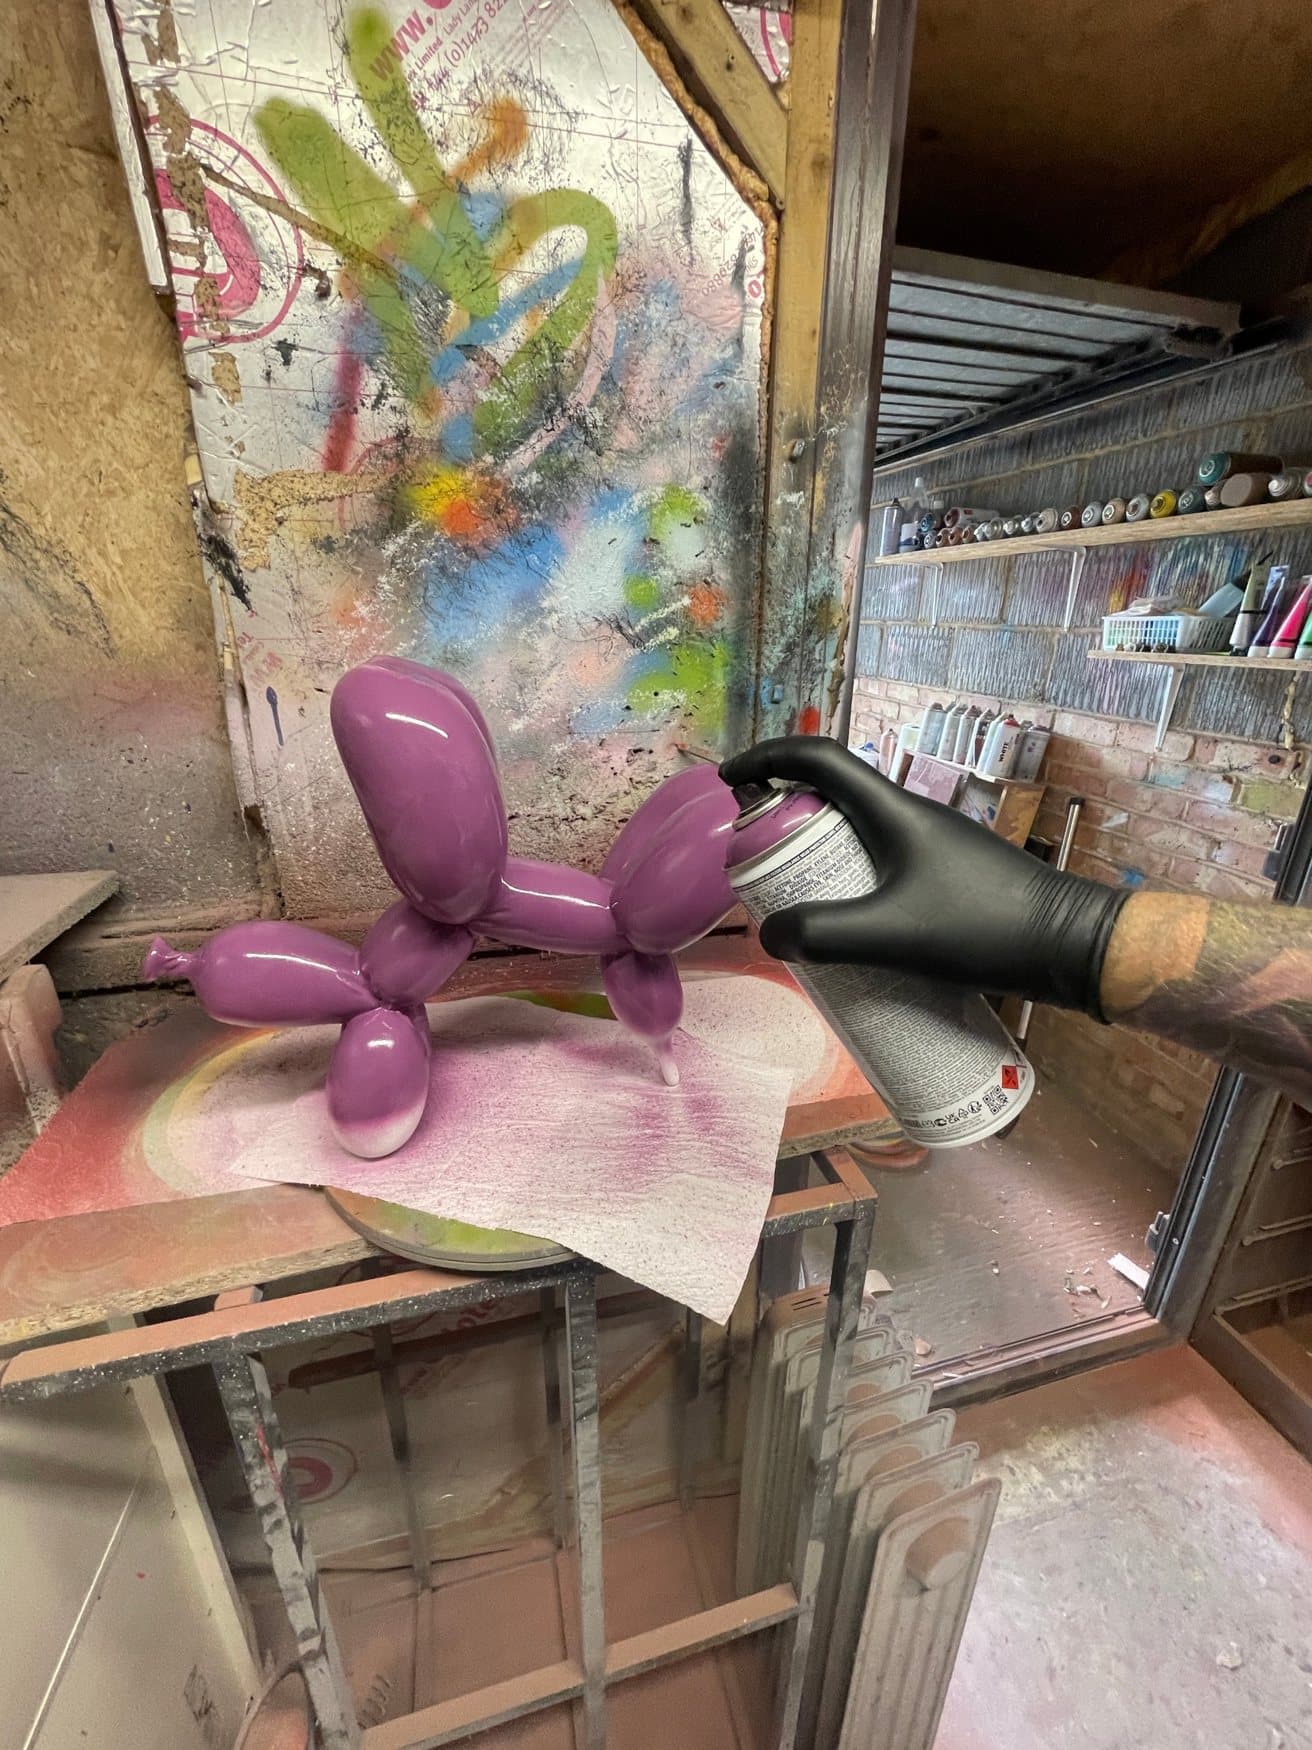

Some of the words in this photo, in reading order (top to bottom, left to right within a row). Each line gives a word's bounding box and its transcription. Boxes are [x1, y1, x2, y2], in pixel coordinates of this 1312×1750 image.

[369, 0, 451, 81] www.
[415, 36, 443, 70] Limited
[443, 14, 463, 36] Lady
[445, 16, 489, 68] (0)1473
